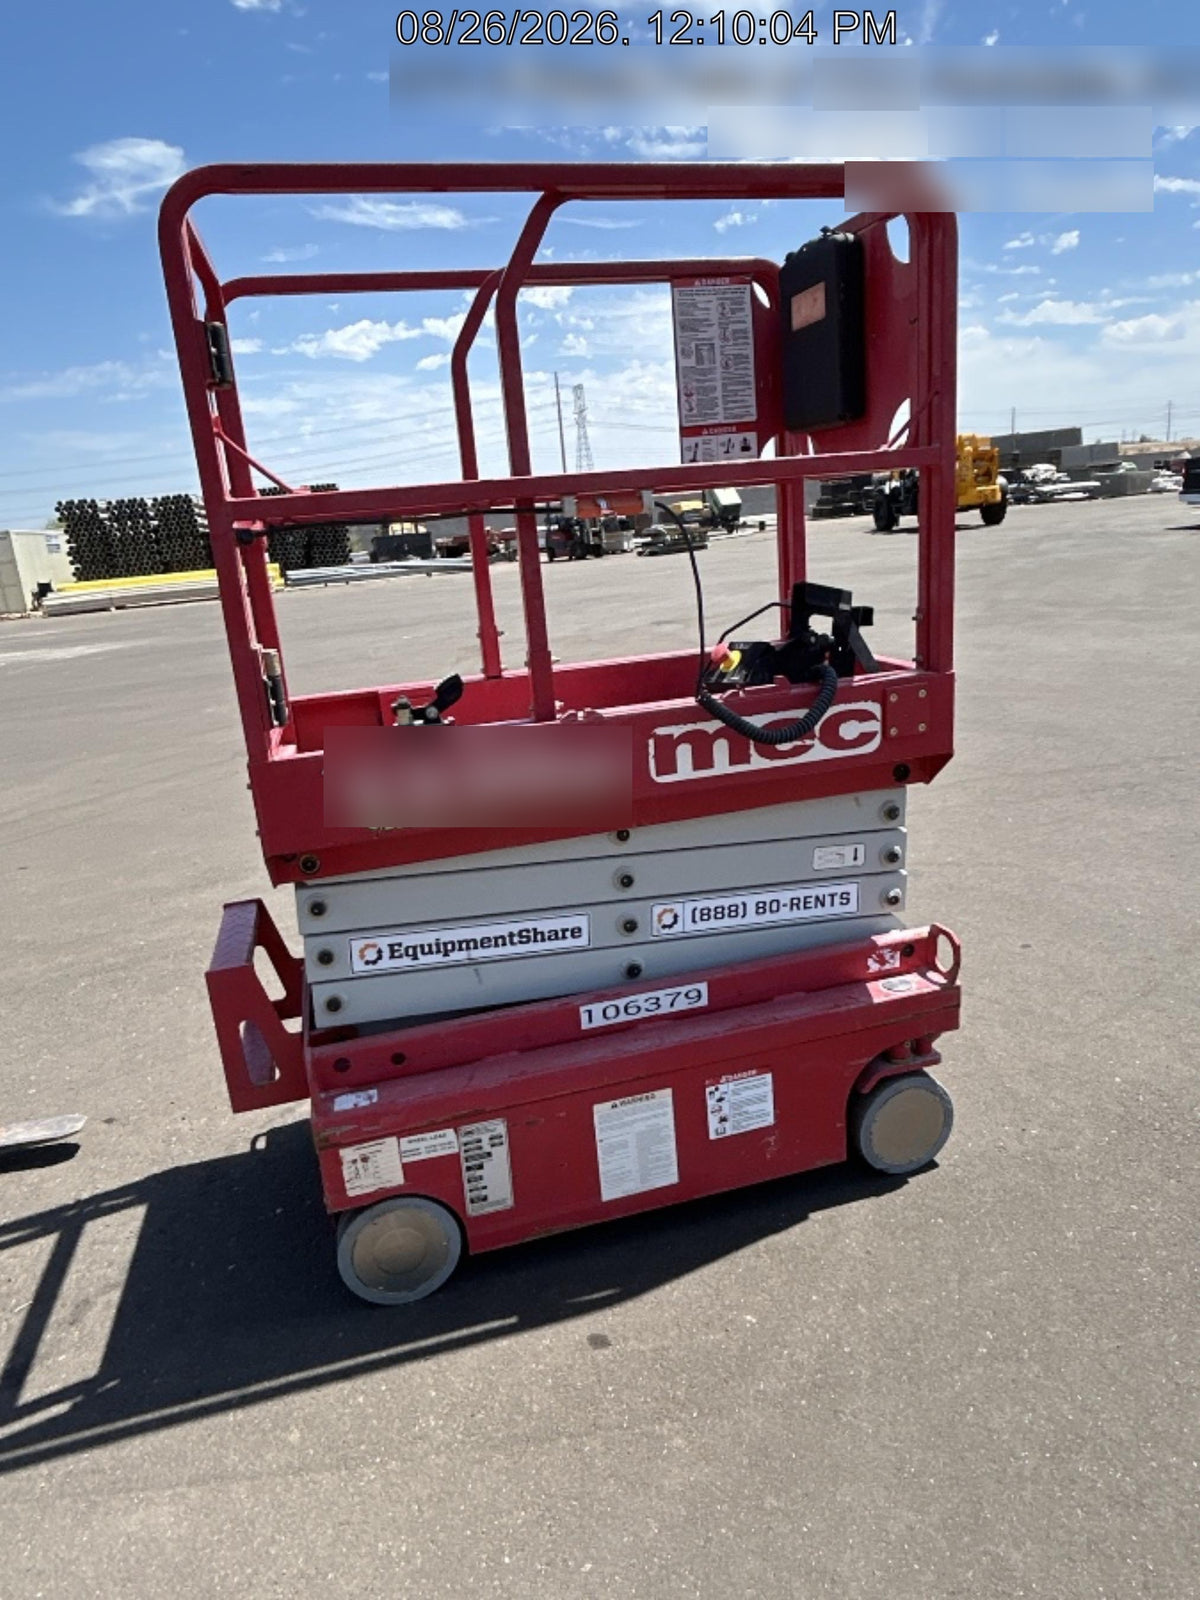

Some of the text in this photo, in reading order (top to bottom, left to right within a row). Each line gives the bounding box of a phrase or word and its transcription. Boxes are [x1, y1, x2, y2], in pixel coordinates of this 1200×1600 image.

[691, 902, 748, 923] (888)
[387, 925, 583, 961] EquipmentShare
[582, 987, 703, 1025] 106379
